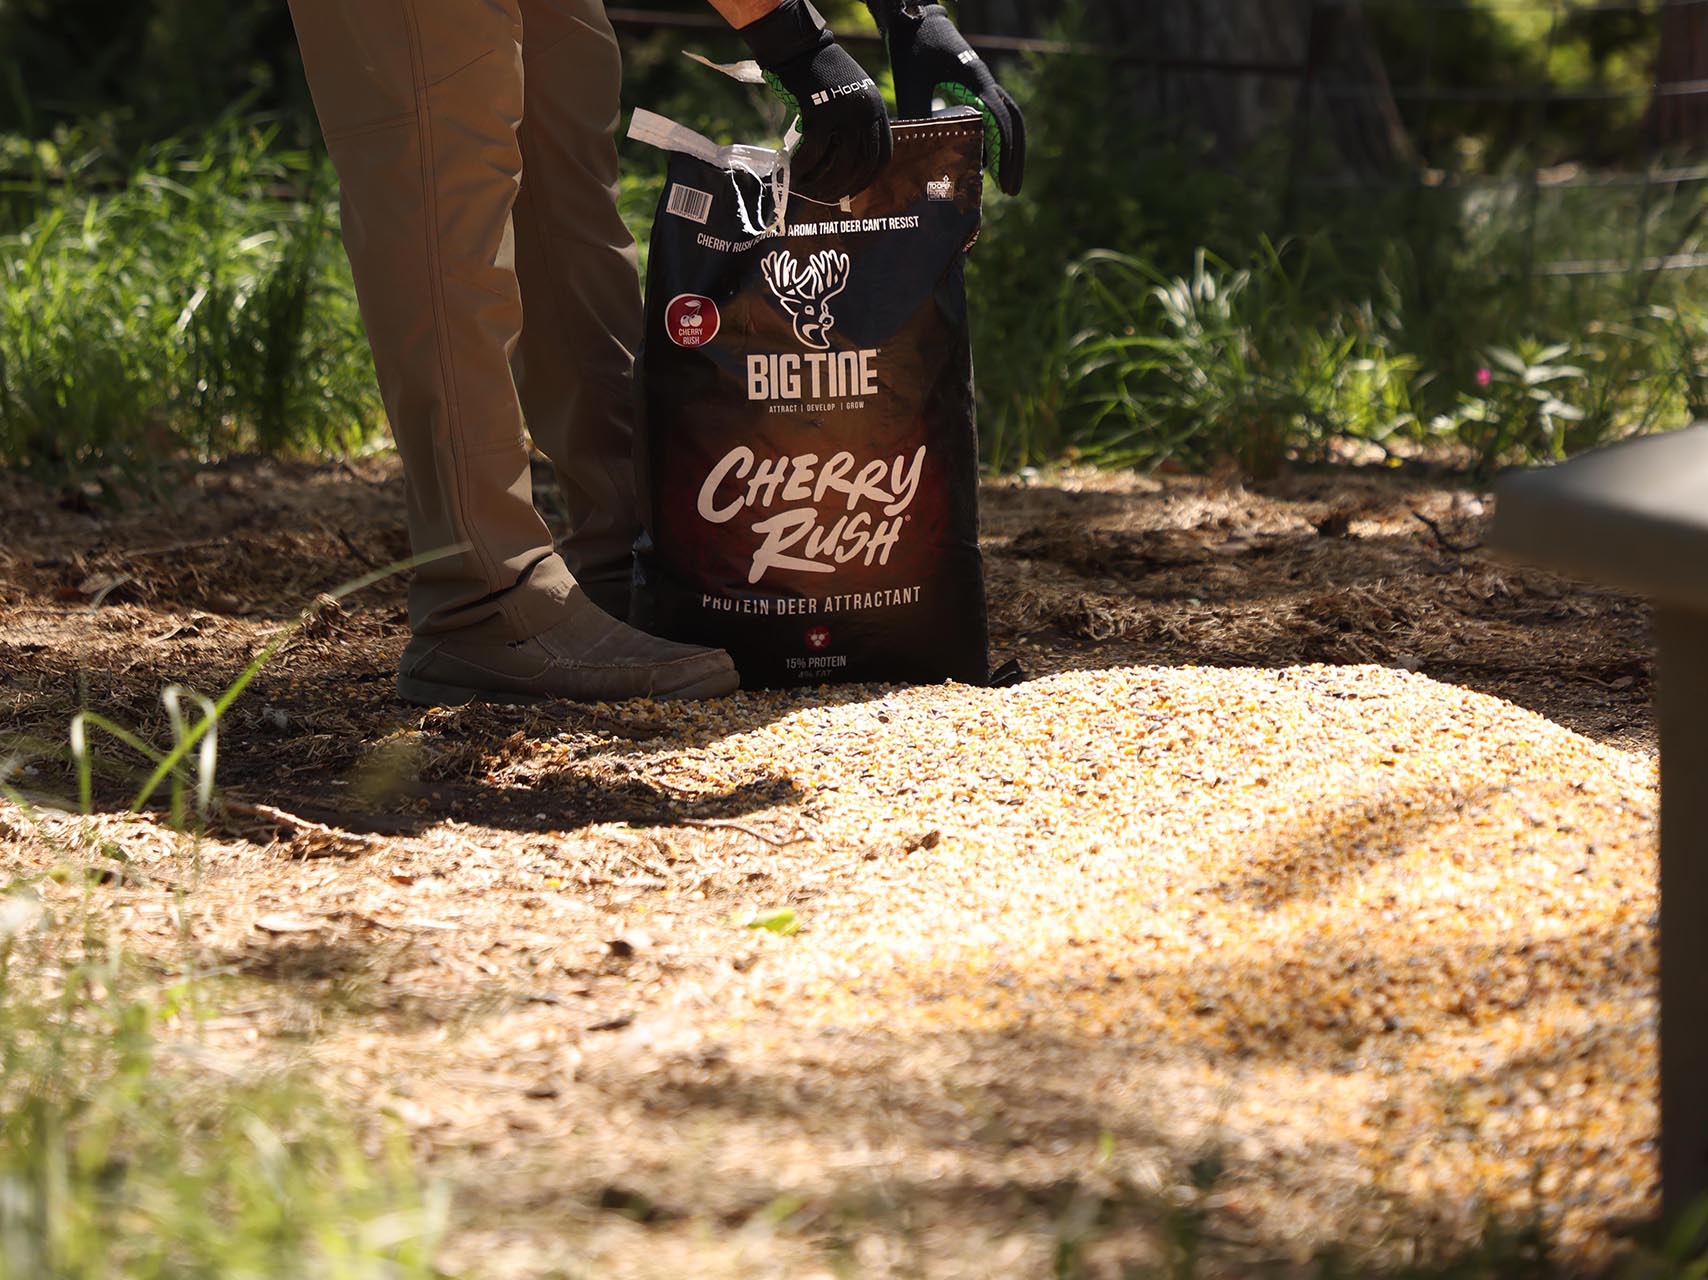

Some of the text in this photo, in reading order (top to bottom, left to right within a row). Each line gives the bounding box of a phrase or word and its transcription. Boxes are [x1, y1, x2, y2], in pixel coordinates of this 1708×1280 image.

[696, 232, 732, 252] CHERRY
[732, 239, 754, 252] RUSH
[788, 223, 818, 237] AROMA
[819, 221, 839, 235] THAT
[840, 219, 861, 233] DEER
[862, 218, 888, 232] CAN'T
[889, 216, 920, 230] RESIST
[678, 328, 704, 337] CHERRY
[682, 336, 700, 345] RUSH
[747, 349, 878, 401] BIG TINE
[769, 401, 865, 414] ATTRACT DEVELOP GROW
[697, 445, 927, 524] CHERRY
[748, 507, 904, 584] RUSH
[777, 597, 817, 615] DEER
[824, 586, 921, 612] ATTRACTANT
[786, 655, 847, 669] 15% PROTEIN
